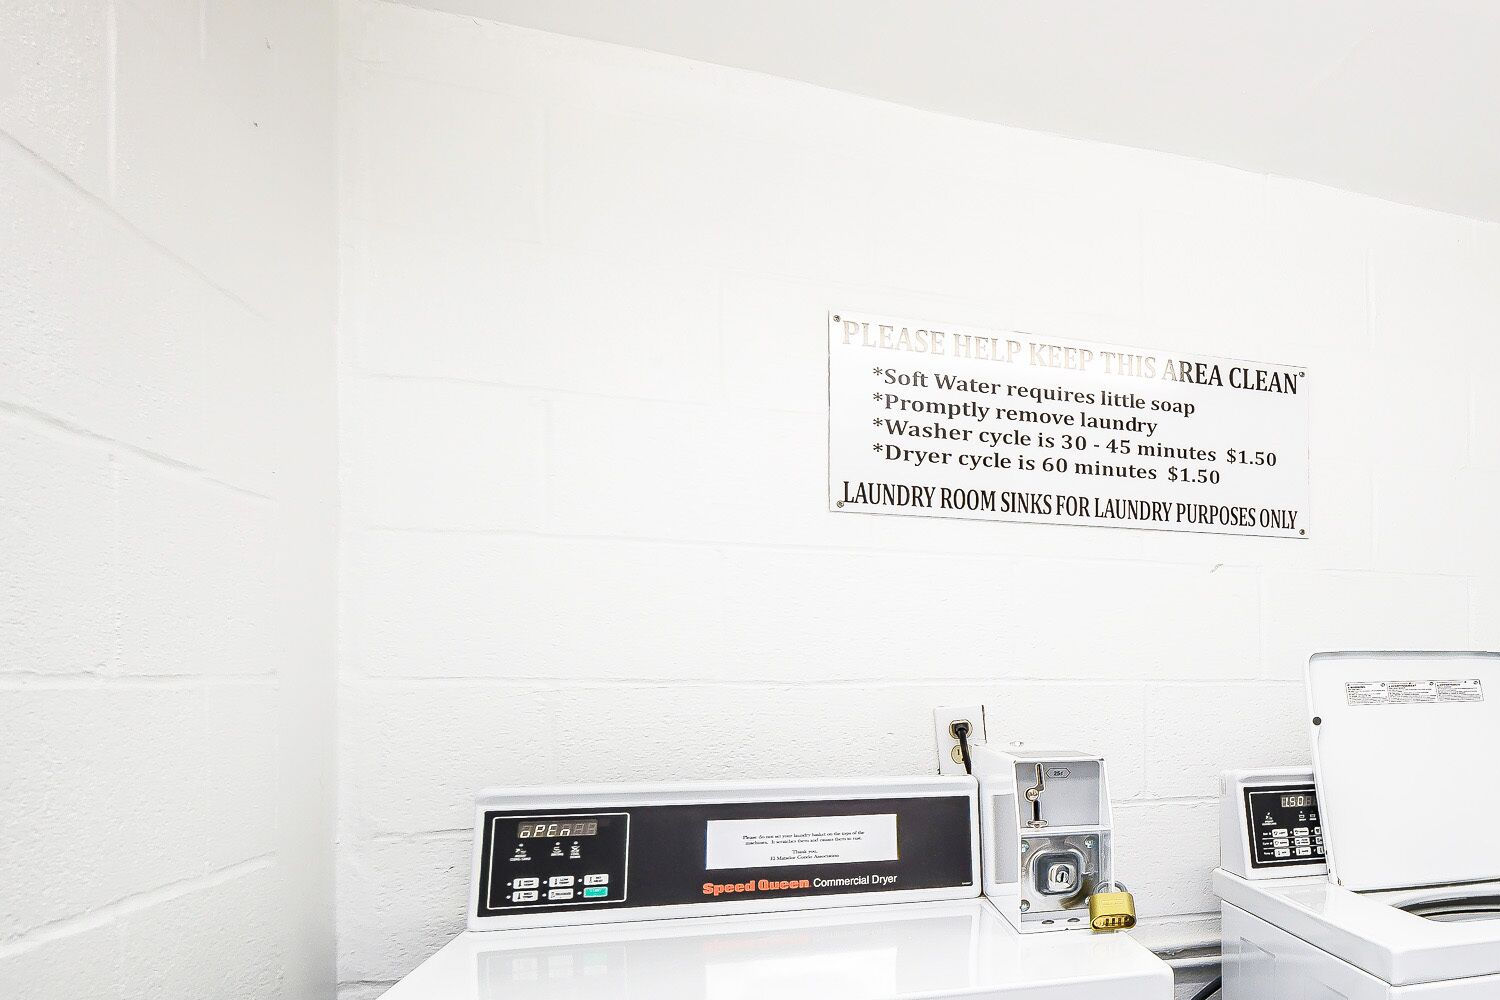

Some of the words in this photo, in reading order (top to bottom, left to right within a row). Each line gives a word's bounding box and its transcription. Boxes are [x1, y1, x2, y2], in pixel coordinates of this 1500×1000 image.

[842, 320, 945, 355] PLEASE
[953, 333, 1021, 363] HELP
[1029, 342, 1093, 371] KEEP
[1100, 351, 1156, 379] THIS
[1161, 358, 1223, 387] AREA
[1229, 367, 1298, 395] CLEAN
[934, 373, 1001, 394] Water
[1006, 384, 1095, 406] requires
[1100, 390, 1146, 409] little
[1150, 400, 1195, 418] soap
[996, 407, 1075, 426] remove
[1080, 412, 1157, 437] laundry
[979, 429, 1031, 447] cycle
[1037, 432, 1055, 448] is
[1061, 434, 1087, 450] 30
[1106, 438, 1131, 454] 45
[1137, 442, 1217, 462] minutes
[1226, 447, 1277, 467] $1.50
[958, 452, 1011, 470] cycle
[1018, 454, 1035, 471] is
[1042, 457, 1068, 474] 60
[1074, 460, 1157, 480] minutes
[1168, 465, 1220, 485] $1.50
[843, 481, 936, 508] LAUNDRY
[940, 487, 996, 512] ROOM
[1000, 491, 1052, 515] SINKS
[1056, 495, 1090, 517] FOR
[1094, 497, 1172, 522] LAUNDRY
[1176, 503, 1256, 527] PURPOSES
[1260, 508, 1298, 530] ONLY
[703, 880, 756, 896] Speed
[758, 879, 809, 891] Queen
[813, 877, 869, 888] Commercial
[871, 874, 898, 885] Dryer
